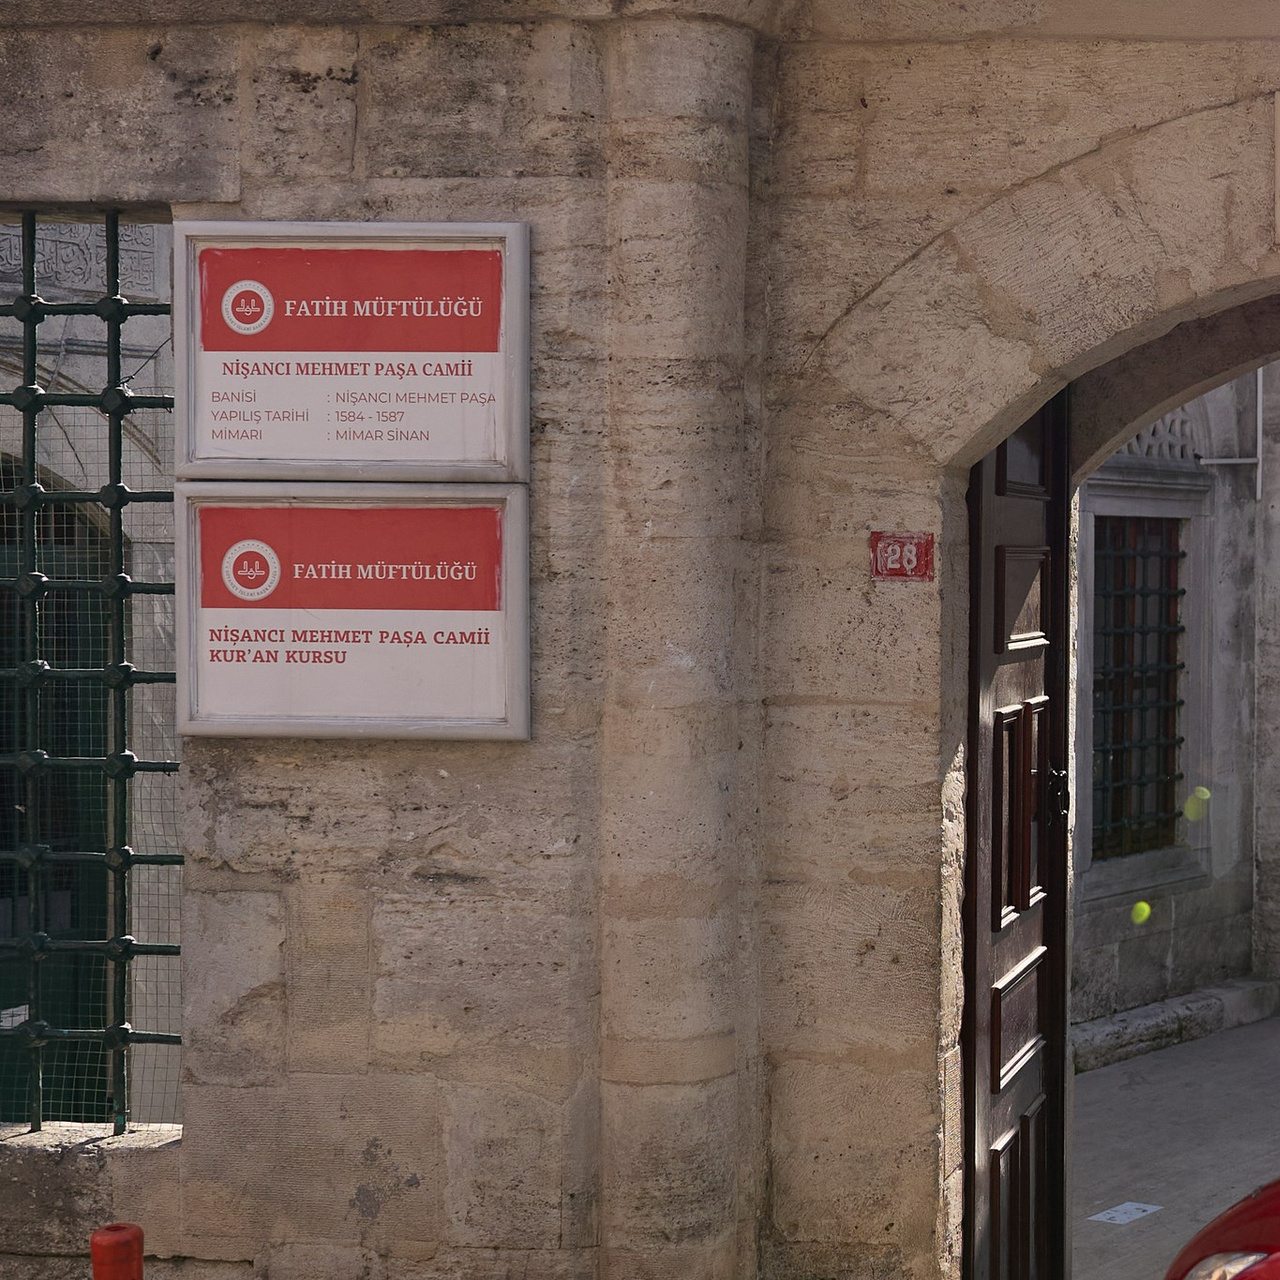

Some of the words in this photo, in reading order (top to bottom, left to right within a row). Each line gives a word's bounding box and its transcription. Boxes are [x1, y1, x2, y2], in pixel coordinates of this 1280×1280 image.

[284, 296, 348, 317] FATİH
[353, 296, 483, 317] MÜFTÜLÜĞÜ
[222, 358, 291, 380] NİŞANCI
[295, 362, 371, 377] MEHMET
[374, 362, 418, 380] PAŞA
[422, 359, 474, 377] CAMİİ
[211, 389, 257, 403] BANİSİ
[335, 389, 392, 406] NİŞANCI
[395, 392, 457, 404] MEHMET
[460, 392, 497, 407] PAŞA
[211, 410, 262, 425] YAPILIŞ
[264, 408, 309, 422] TARİHİ
[335, 411, 366, 423] 1584
[376, 411, 405, 423] 1587
[335, 428, 384, 441] MİMAR
[387, 428, 430, 441] SİNAN
[886, 543, 918, 571] 28
[293, 560, 352, 580] FATİH
[356, 561, 478, 581] MÜFTÜLÜĞÜ
[209, 625, 285, 646] NİŞANCI
[291, 630, 373, 644] MEHMET
[379, 631, 427, 648] PAŞA
[433, 627, 490, 645] CAMİİ
[285, 650, 347, 664] KURSU
